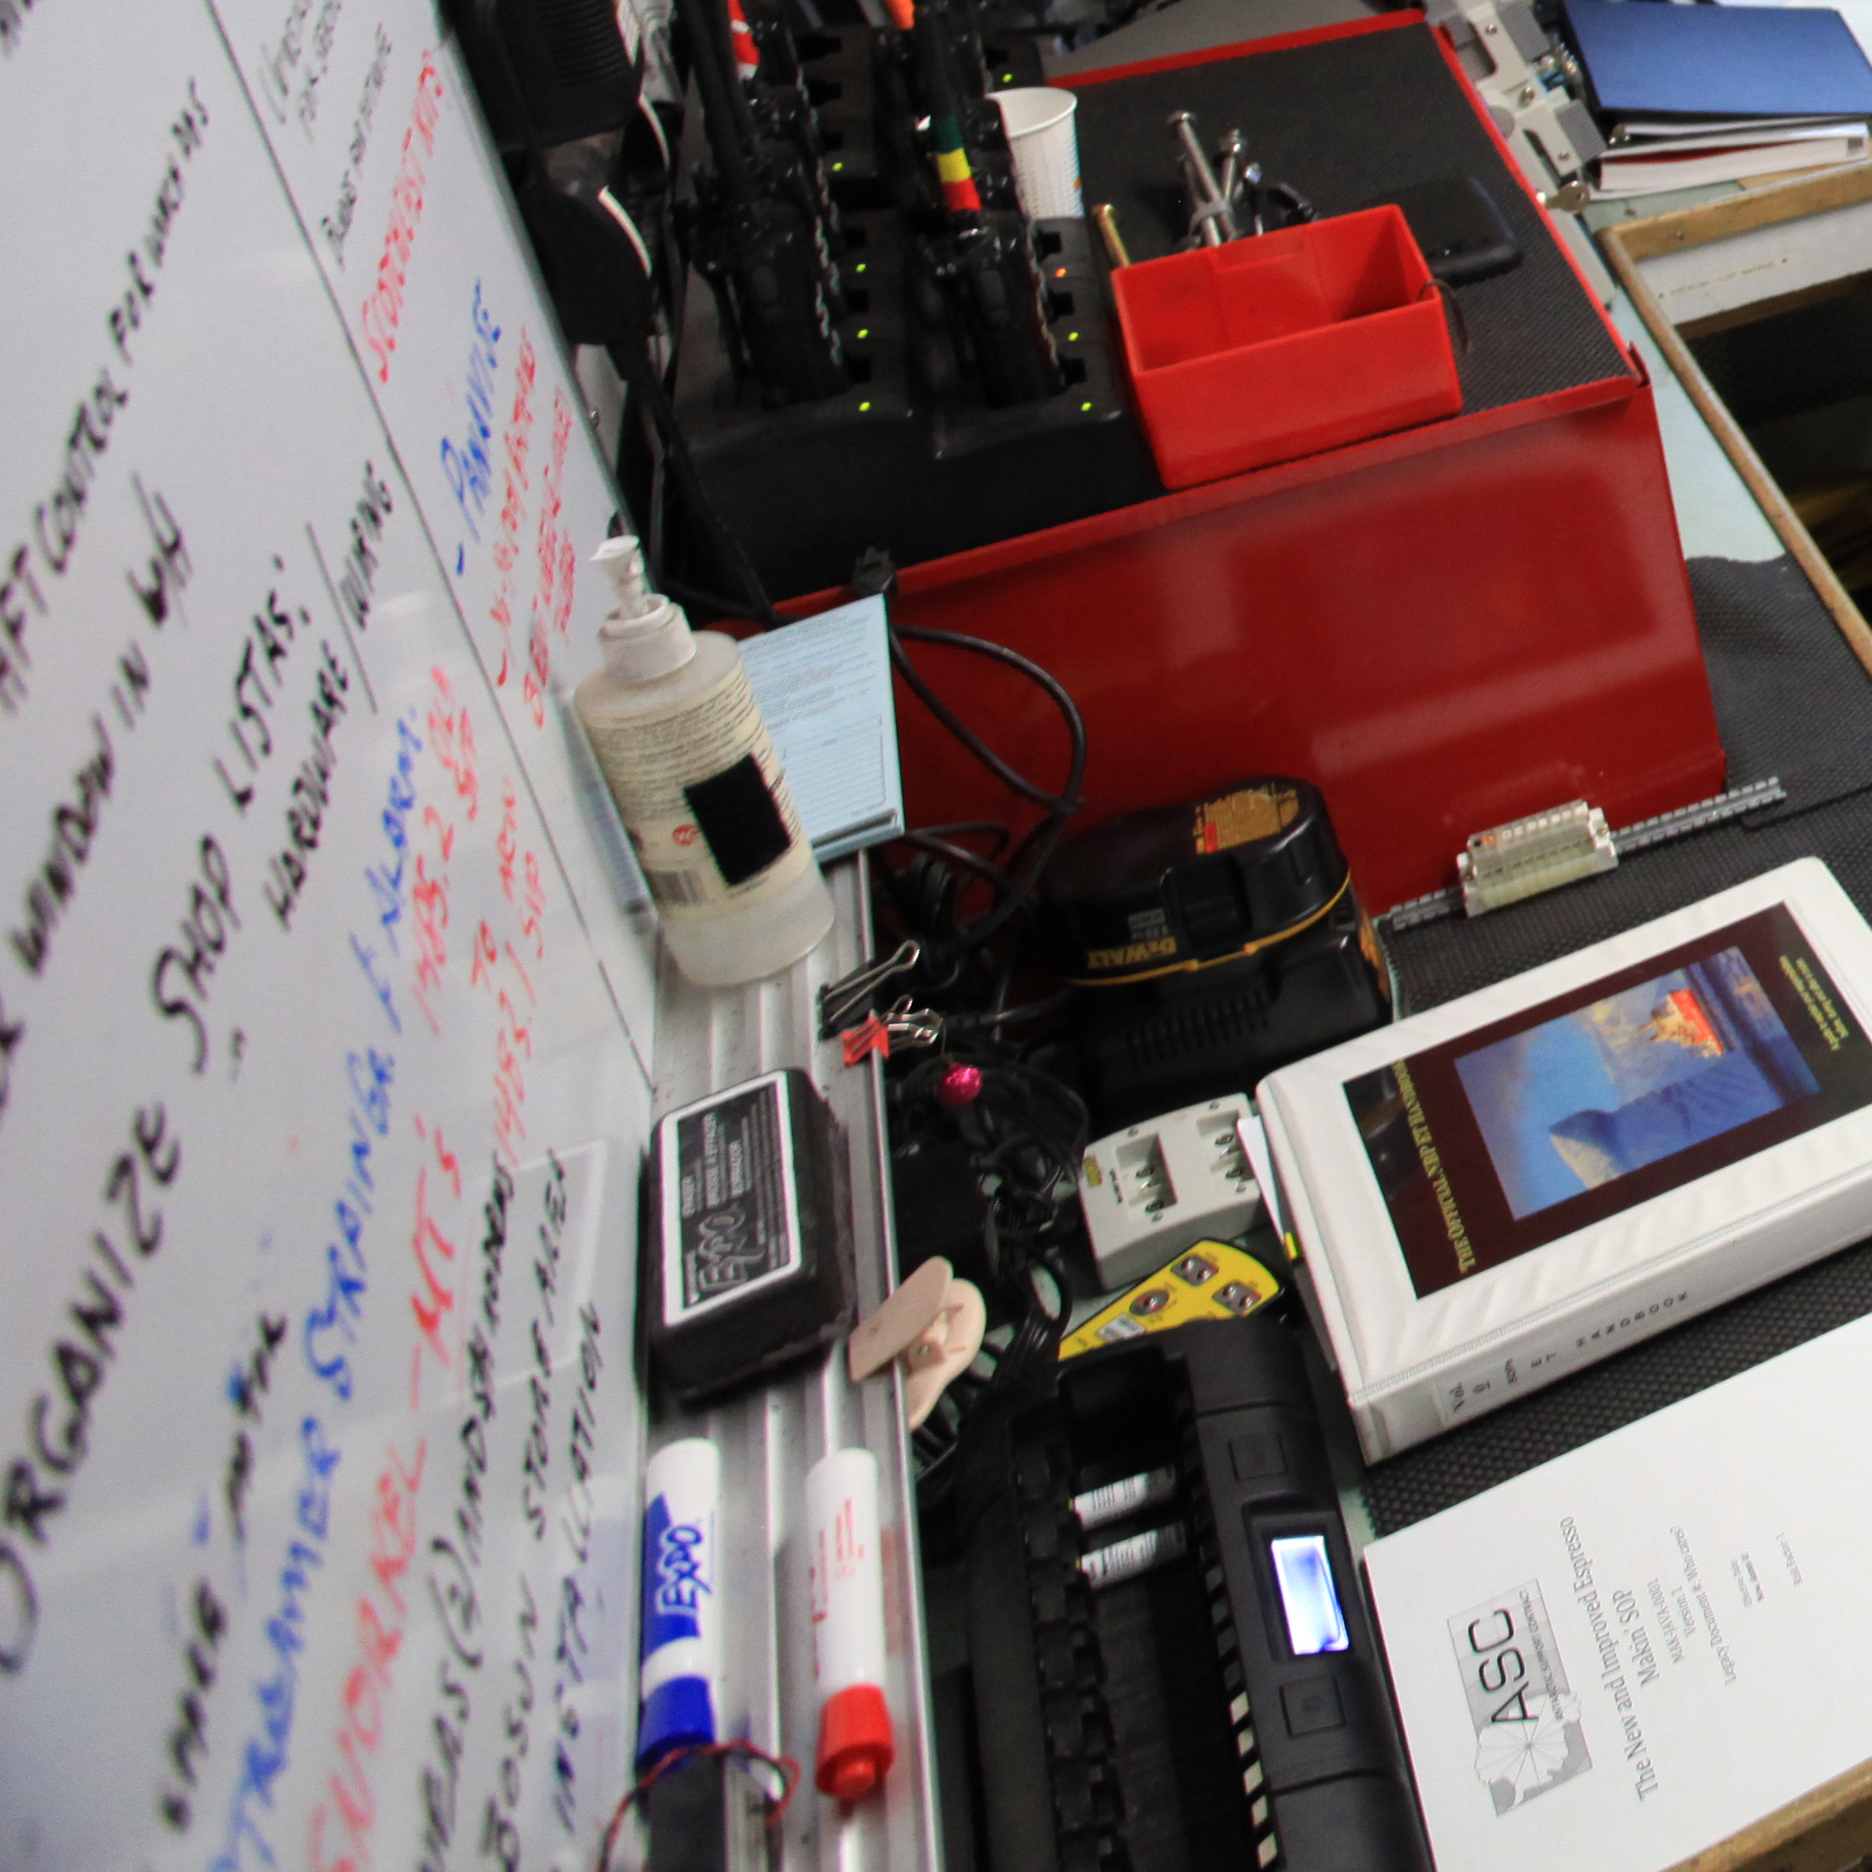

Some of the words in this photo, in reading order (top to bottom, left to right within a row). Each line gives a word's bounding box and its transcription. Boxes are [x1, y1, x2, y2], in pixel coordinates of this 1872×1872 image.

[33, 367, 128, 576] CONTROL
[108, 250, 153, 366] FOR
[0, 1101, 182, 1676] ORGANIZE
[151, 832, 242, 1075] SHOP
[697, 1196, 767, 1301] EXPO
[657, 1524, 712, 1614] EXPO
[1560, 1517, 1593, 1593] Espresso
[1667, 1528, 1689, 1554] cares?
[1678, 1552, 1700, 1584] Who
[1610, 1582, 1644, 1624] SOP
[1644, 1573, 1688, 1667] MAK-JAVA-0001
[1672, 1591, 1700, 1637] Version
[1696, 1592, 1726, 1647] Document
[1578, 1590, 1620, 1679] Improved
[1624, 1619, 1664, 1686] Makin'
[1467, 1607, 1540, 1724] ASC
[1601, 1672, 1635, 1711] and
[1717, 1647, 1736, 1684] Legacy
[1622, 1716, 1646, 1760] New
[1635, 1759, 1658, 1801] The
